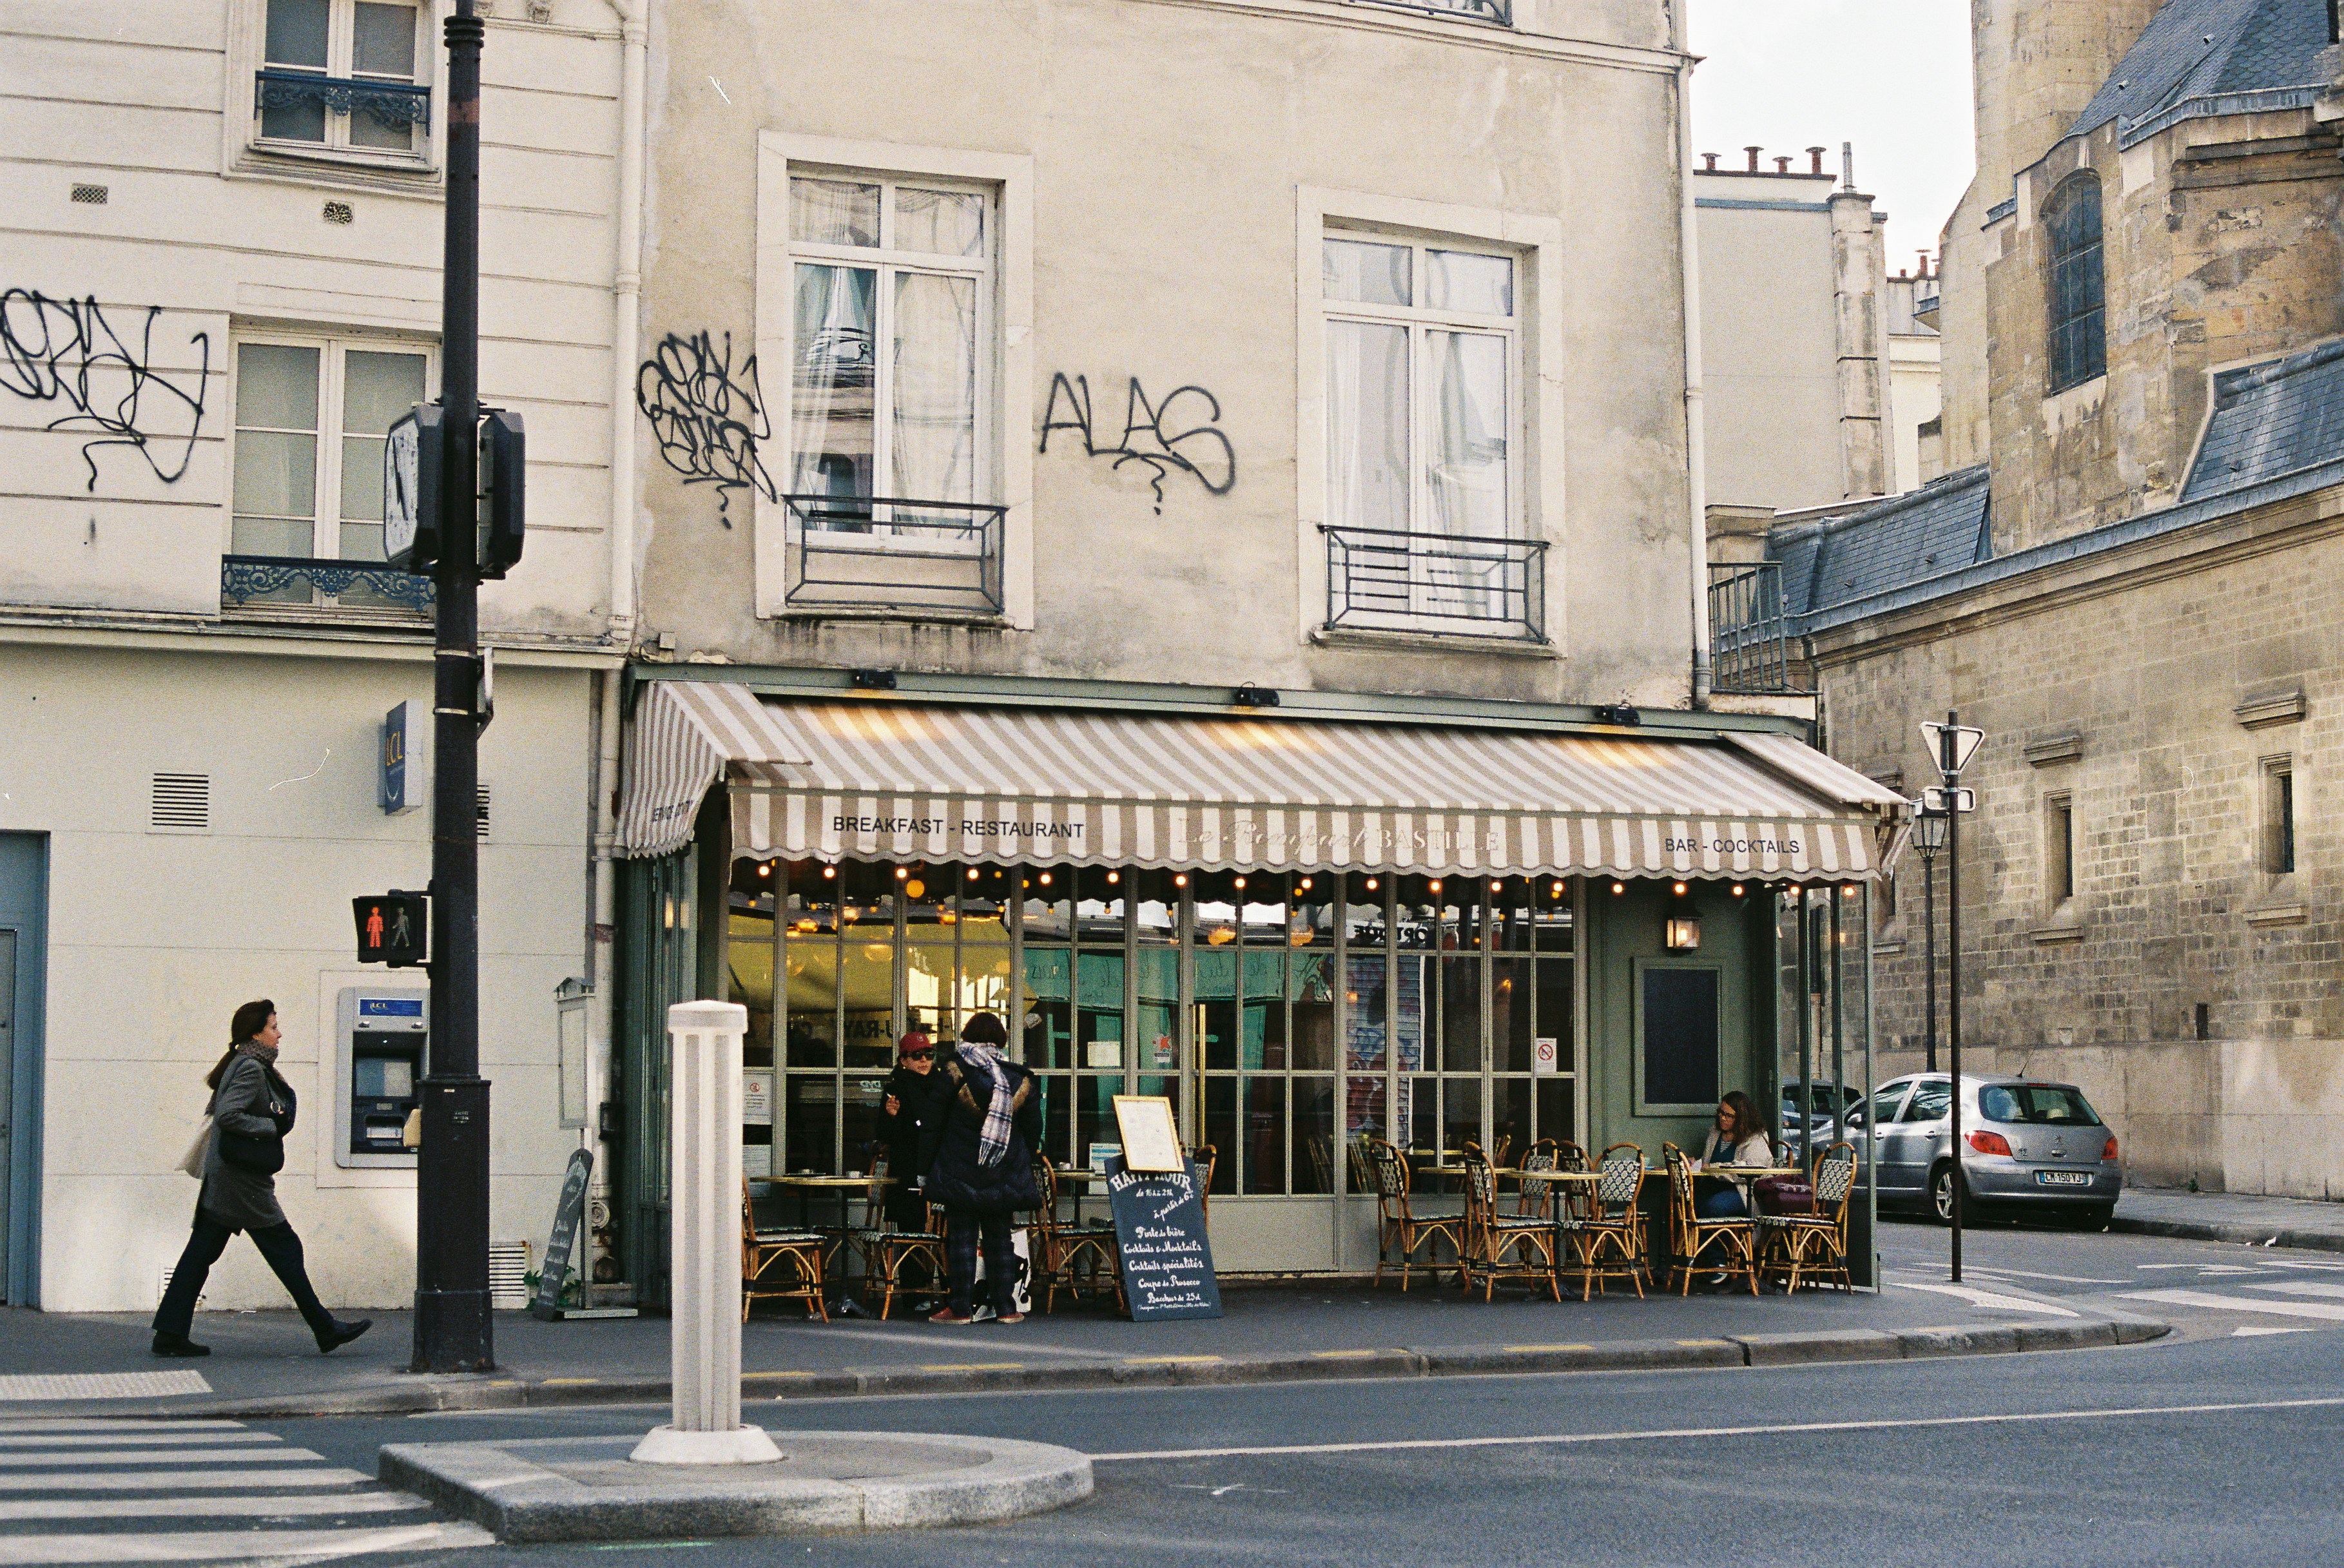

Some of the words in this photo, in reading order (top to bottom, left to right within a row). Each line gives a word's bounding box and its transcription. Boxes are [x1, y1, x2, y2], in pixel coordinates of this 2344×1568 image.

[833, 816, 944, 835] BREAKFAST
[961, 819, 1085, 838] RESTAURANT
[1376, 828, 1500, 851] BASTILLE
[1665, 838, 1698, 852] BAR
[1713, 839, 1800, 854] COCKTAILS
[1135, 1226, 1159, 1239] Pinte
[1167, 1225, 1186, 1237] bière
[1123, 1243, 1154, 1253] Cocktails
[1162, 1240, 1203, 1253] Mocktails
[1128, 1259, 1161, 1272] Cocktails
[1161, 1257, 1204, 1273] spécialités
[1138, 1278, 1161, 1292] Coupe
[1170, 1275, 1201, 1287] Prosecco
